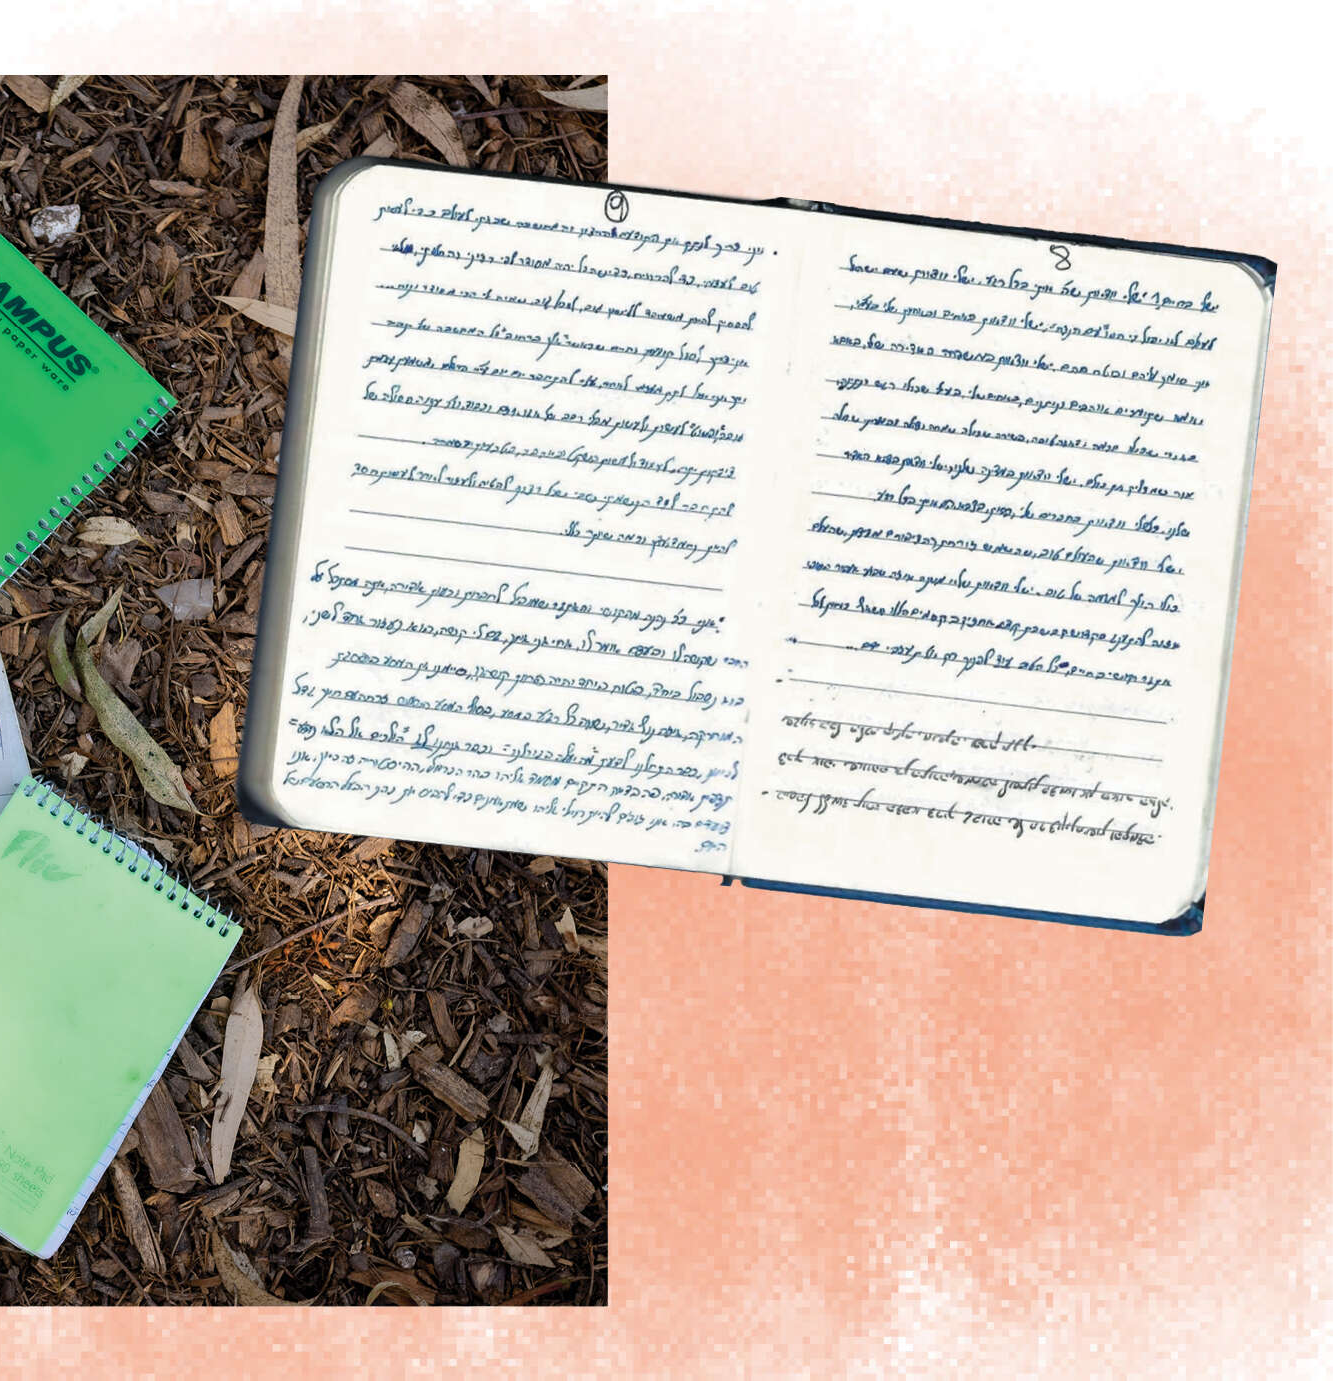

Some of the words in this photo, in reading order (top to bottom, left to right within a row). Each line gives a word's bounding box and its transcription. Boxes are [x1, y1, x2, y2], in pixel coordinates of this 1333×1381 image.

[1049, 244, 1071, 271] 8
[1, 326, 39, 361] paper
[40, 361, 71, 392] ware
